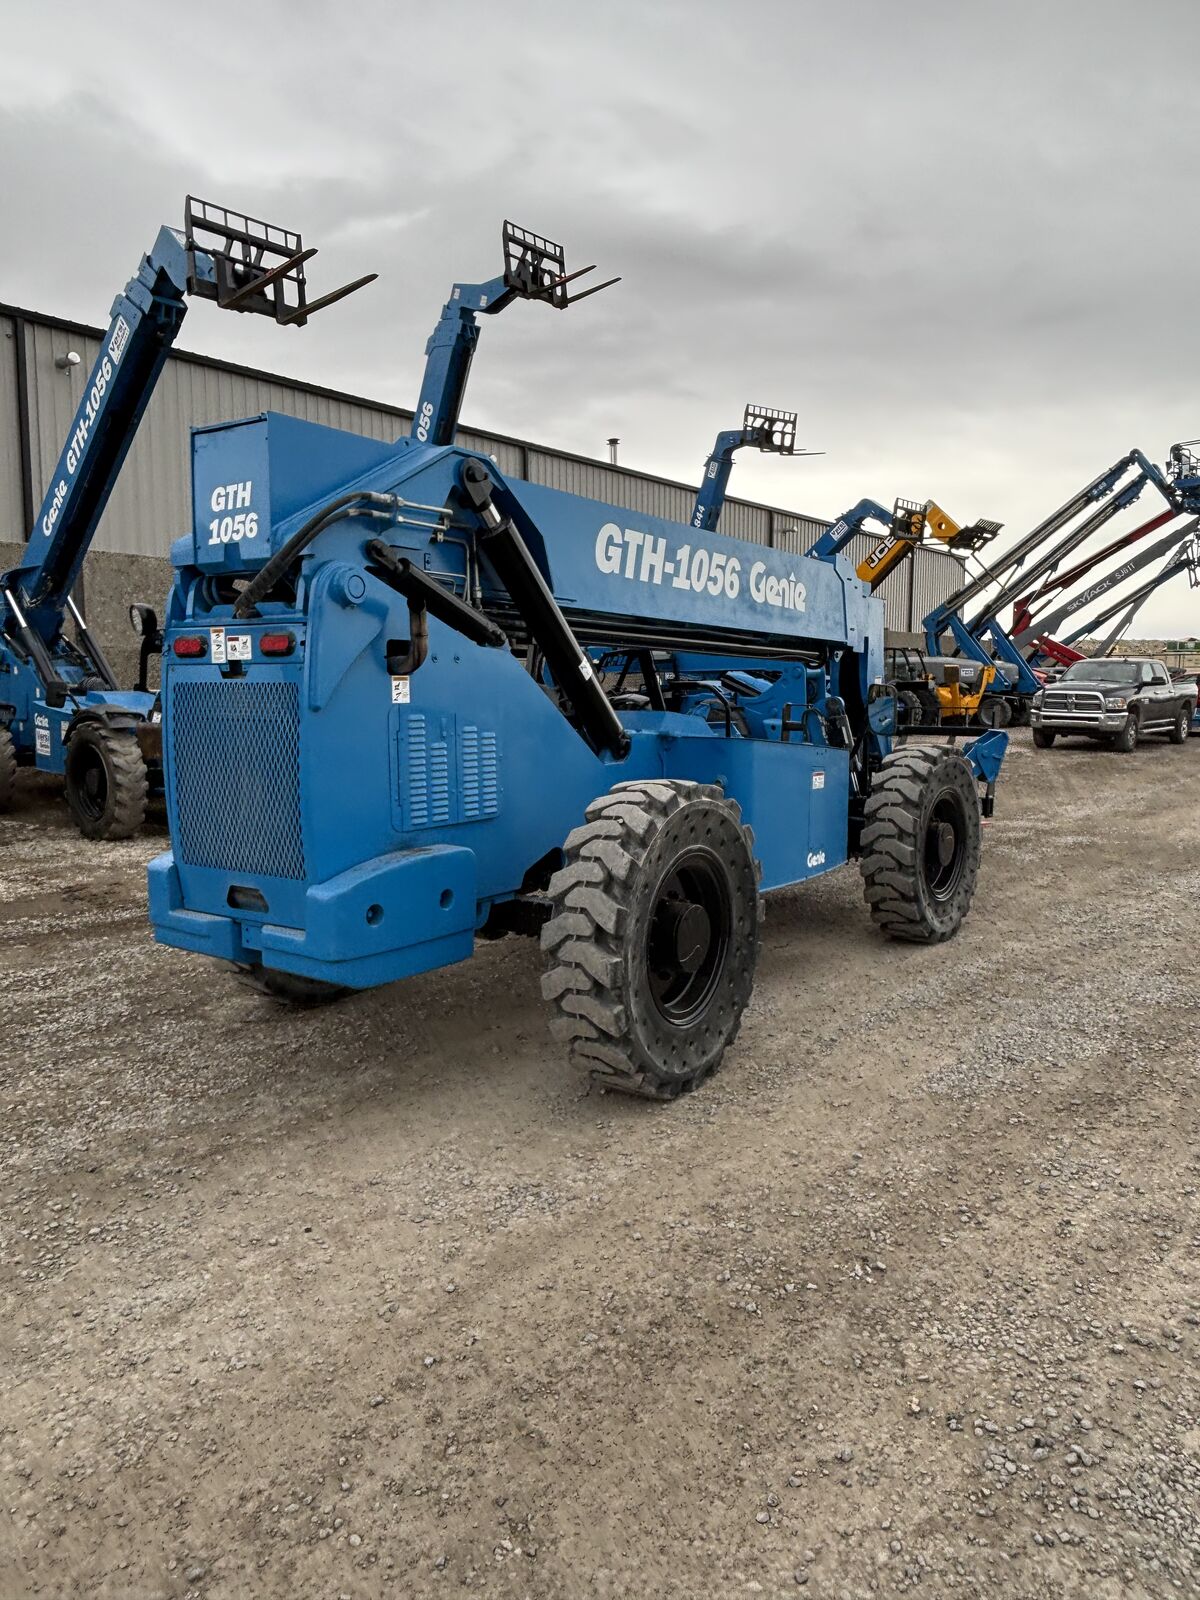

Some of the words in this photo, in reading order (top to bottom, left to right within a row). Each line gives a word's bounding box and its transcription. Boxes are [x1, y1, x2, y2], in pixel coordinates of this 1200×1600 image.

[43, 480, 68, 537] Genie
[66, 356, 112, 475] GTH-1056
[211, 481, 252, 512] GTH
[208, 512, 258, 545] 1056
[595, 523, 741, 599] GTH-1056
[750, 561, 806, 612] Genie
[1066, 580, 1112, 612] SKYJACK
[34, 712, 49, 728] Genie
[807, 851, 826, 868] Genie
